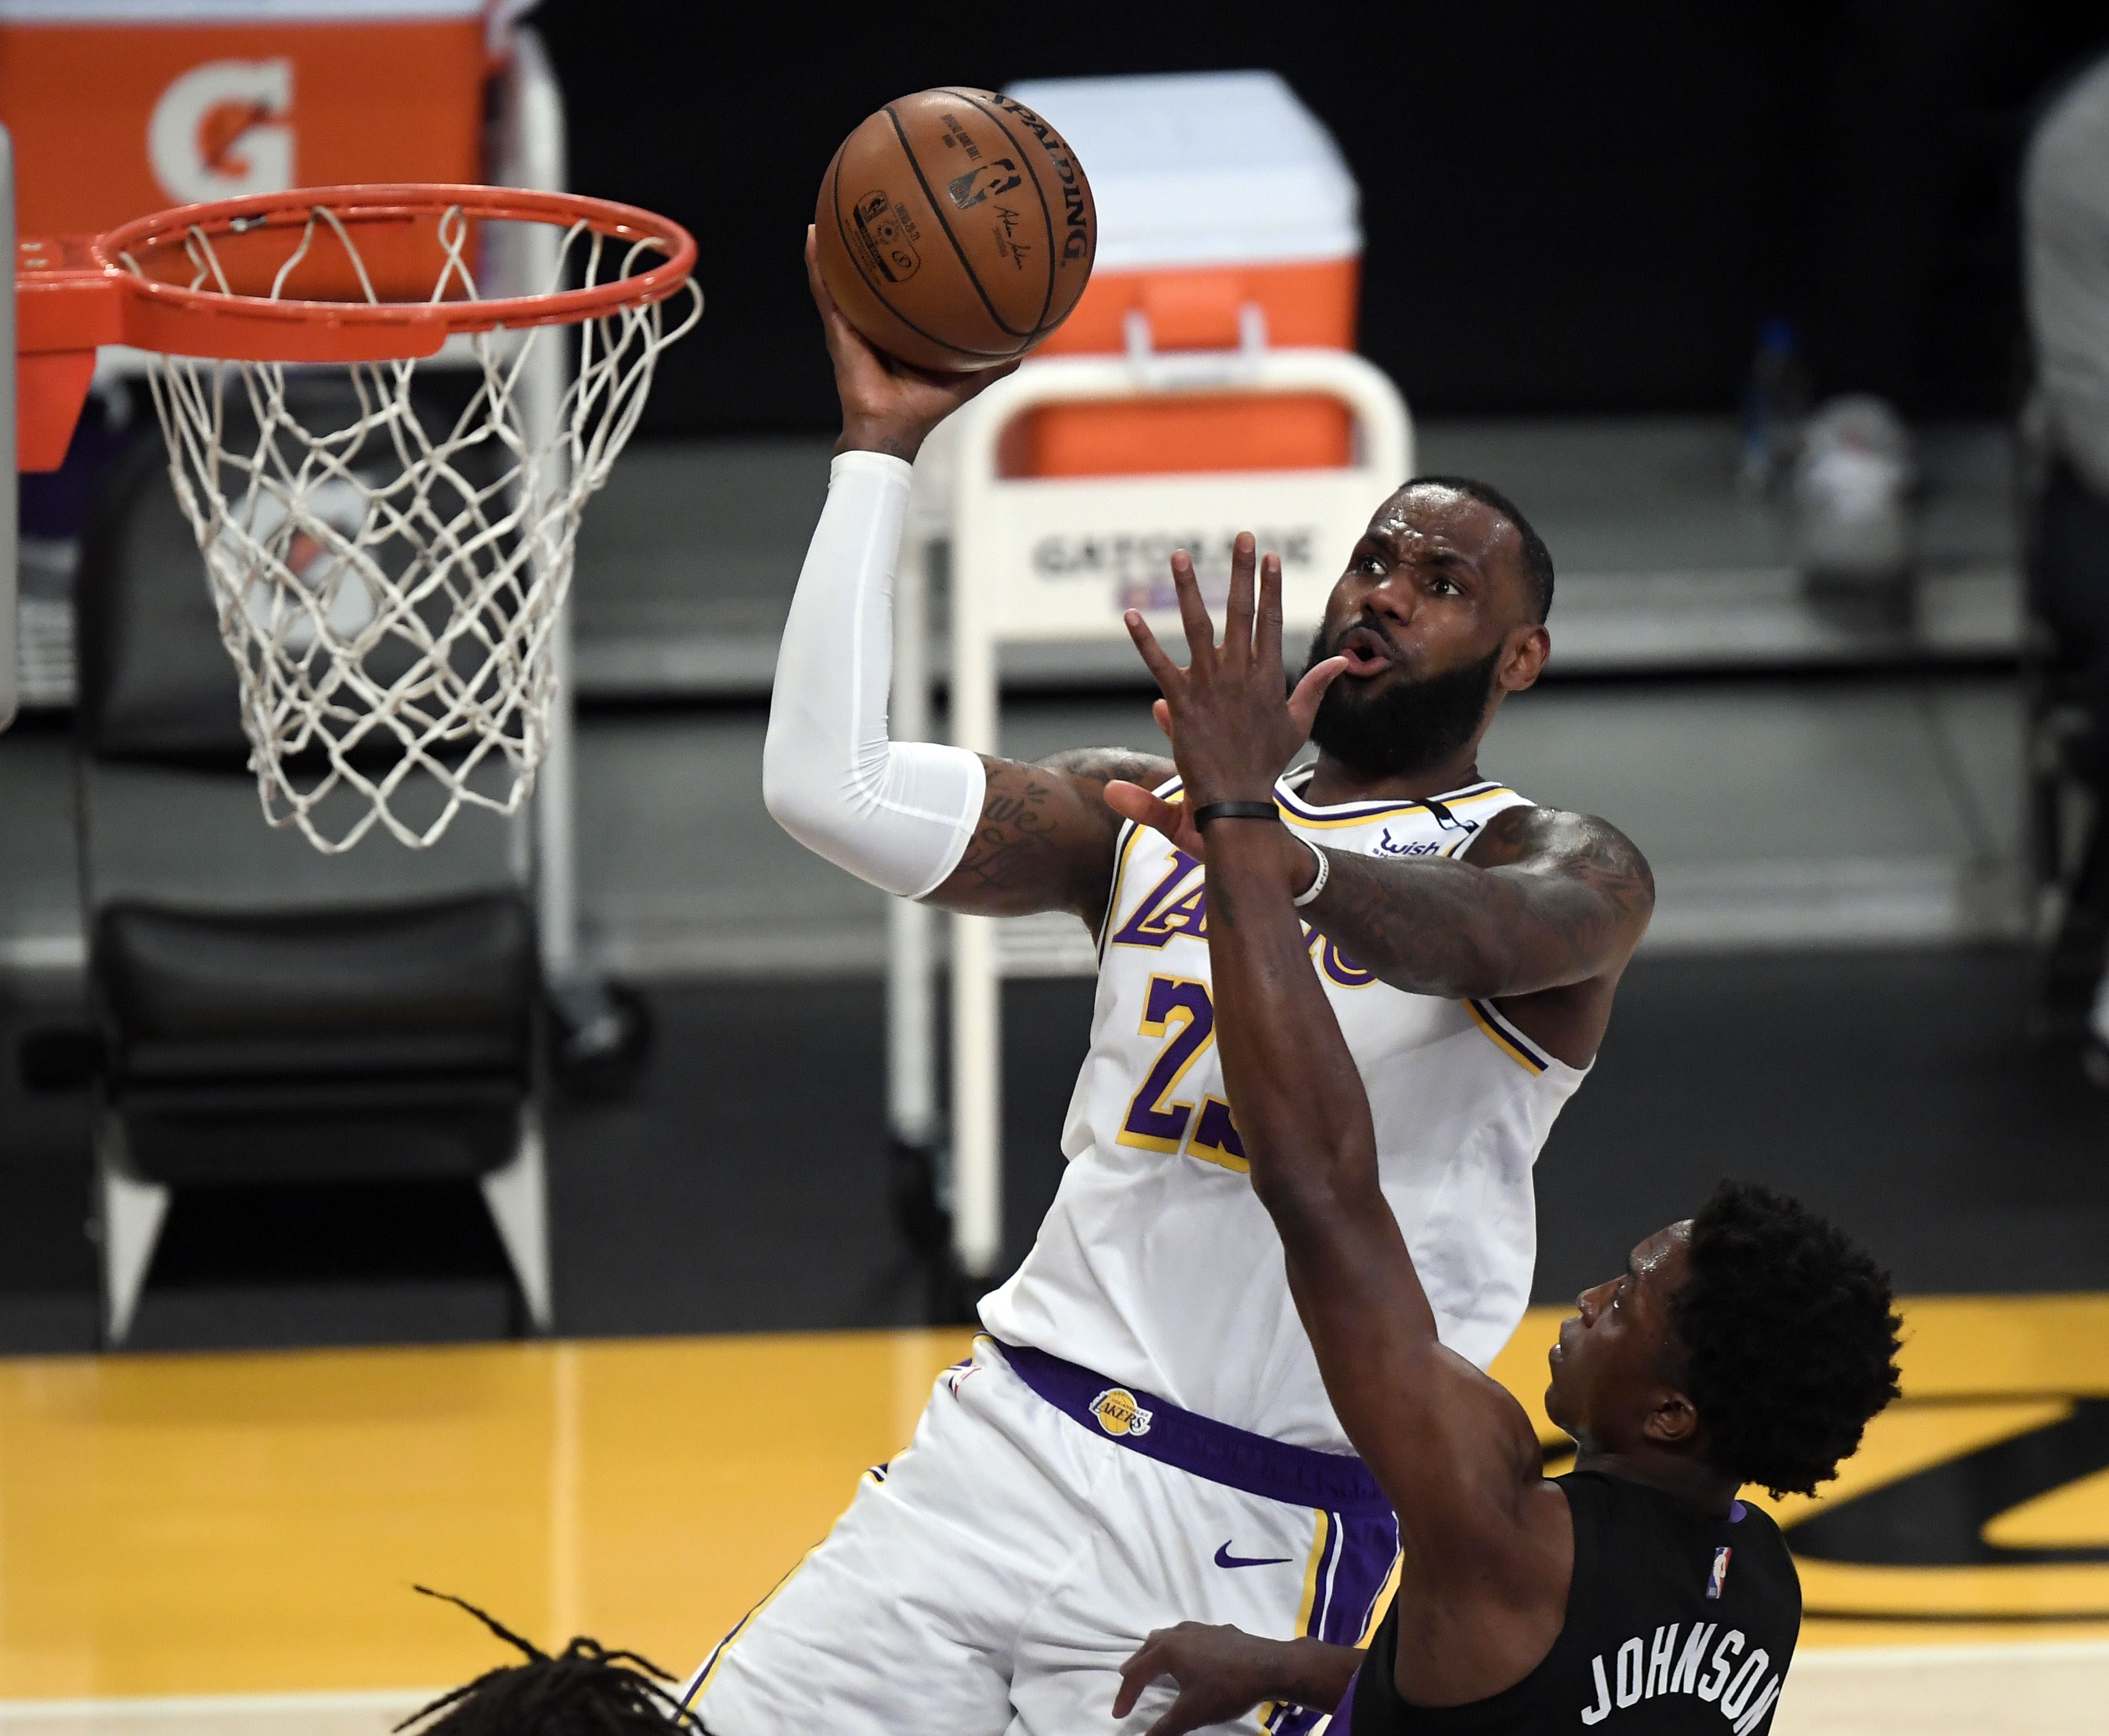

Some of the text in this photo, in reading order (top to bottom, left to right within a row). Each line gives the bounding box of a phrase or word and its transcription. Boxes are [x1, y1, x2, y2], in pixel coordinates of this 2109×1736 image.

[146, 59, 296, 205] G
[979, 94, 1088, 260] SPALDING
[1092, 1394, 1147, 1433] LAKERS
[1581, 1622, 1780, 1736] JOHNSON
